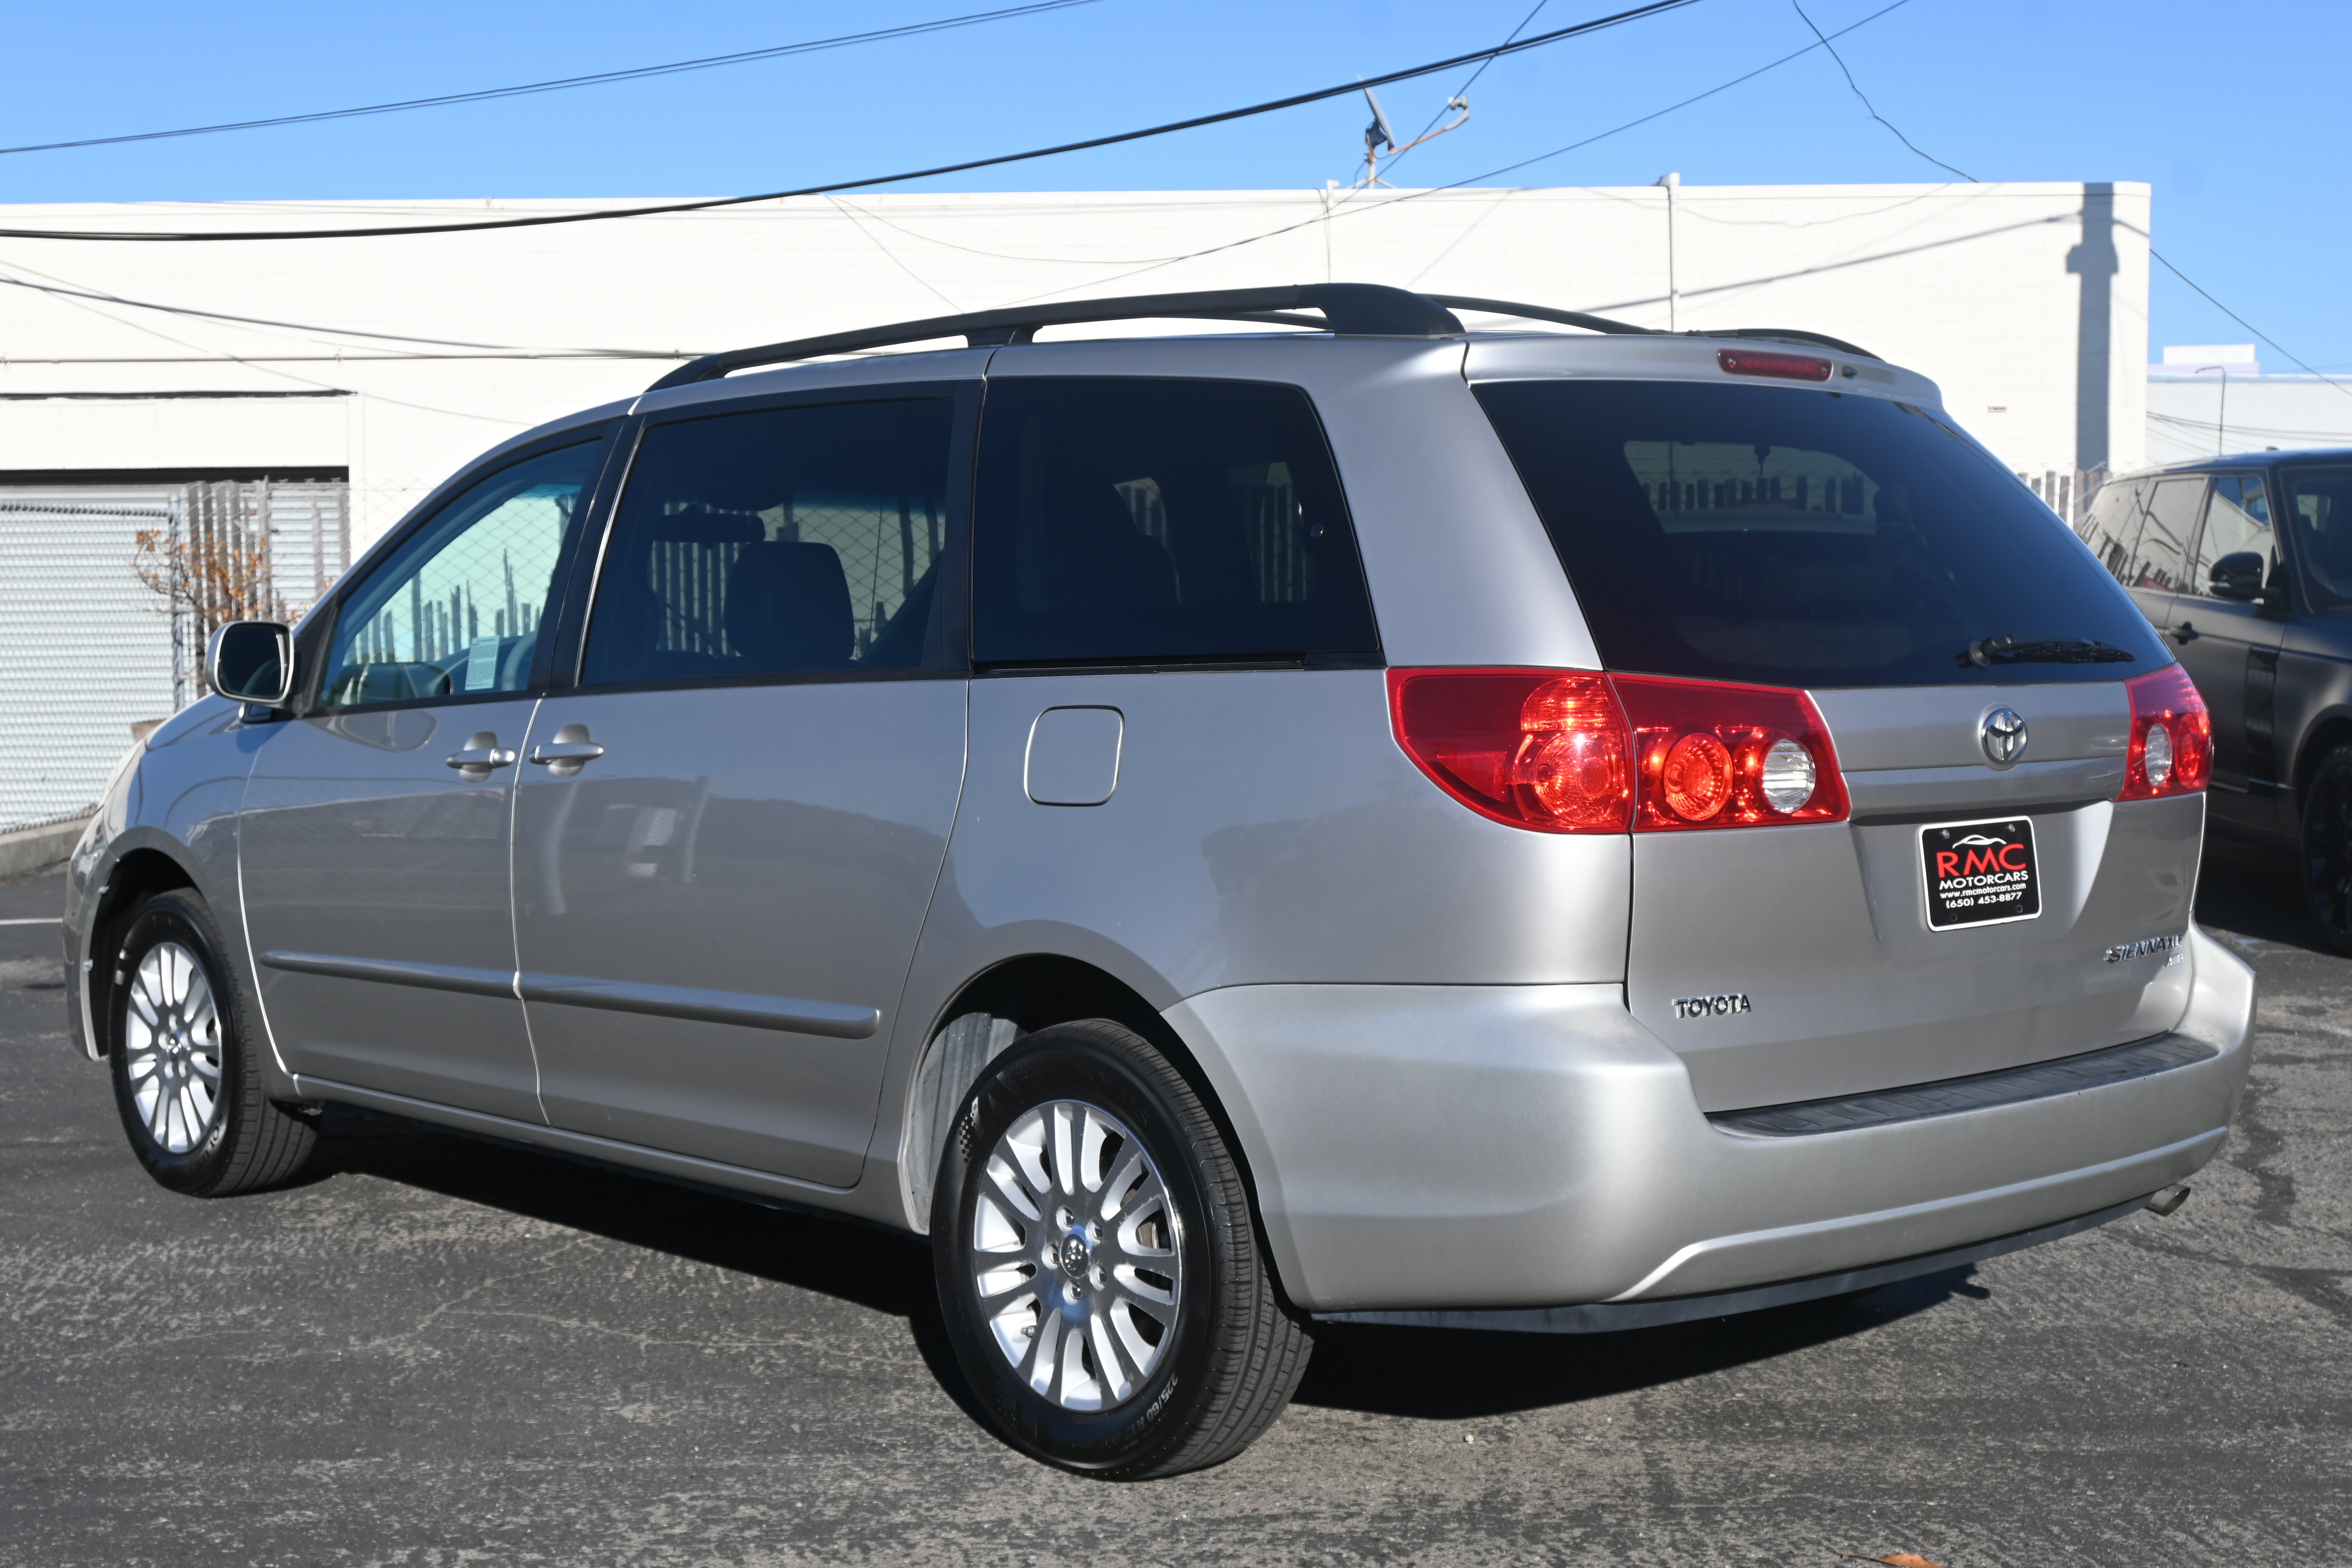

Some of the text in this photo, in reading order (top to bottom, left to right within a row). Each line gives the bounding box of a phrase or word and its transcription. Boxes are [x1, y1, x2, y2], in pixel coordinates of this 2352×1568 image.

[1936, 843, 2027, 878] RMC
[1939, 871, 2028, 890] MOTORCARS
[1940, 882, 2026, 898] www.rmcmotorcars.com
[1946, 892, 2022, 909] (650) 453-8877
[2104, 937, 2166, 964] SIENNA
[1672, 994, 1752, 1018] TOYOTA
[1146, 1372, 1179, 1422] 225/60
